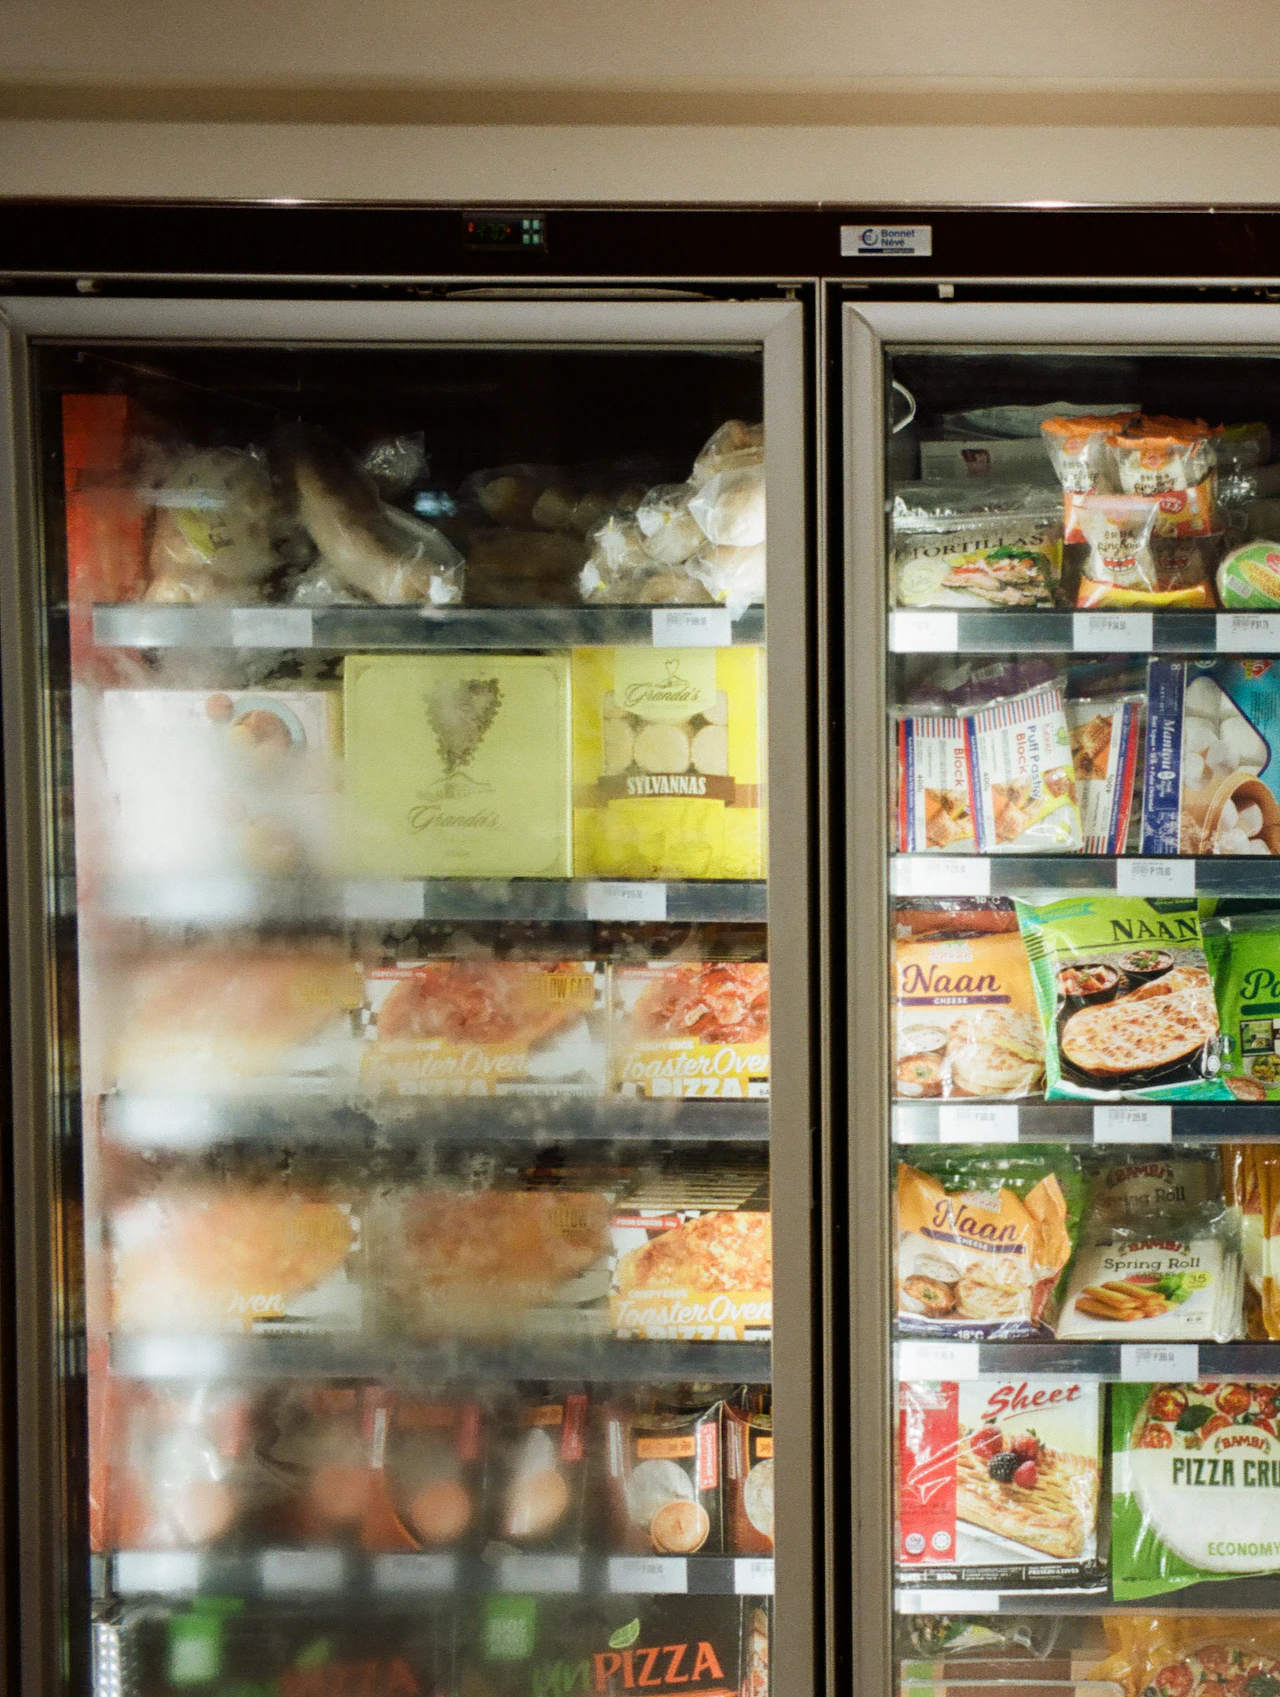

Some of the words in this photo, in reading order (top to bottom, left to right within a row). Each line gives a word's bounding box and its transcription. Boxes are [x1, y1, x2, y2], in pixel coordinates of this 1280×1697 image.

[881, 229, 915, 237] Bonnet
[912, 534, 1046, 560] TORTILLAS
[1015, 732, 1029, 776] Block
[1160, 719, 1177, 770] Mantou
[953, 748, 965, 788] Block
[626, 774, 708, 797] SYLVANNAS
[1109, 917, 1199, 942] NAAN
[902, 963, 1002, 995] Naan
[933, 996, 969, 1005] CHEESE
[652, 1077, 744, 1098] PIZZA
[1155, 1184, 1186, 1202] Roll
[932, 1198, 1019, 1243] Naan
[1104, 1257, 1161, 1272] Spring
[1168, 1256, 1201, 1270] Roll
[1188, 1272, 1208, 1285] 35
[980, 1380, 1082, 1422] Sheet
[1220, 1434, 1266, 1450] BAMBI
[1171, 1457, 1235, 1487] PIZZA
[590, 1640, 726, 1693] PIZZA
